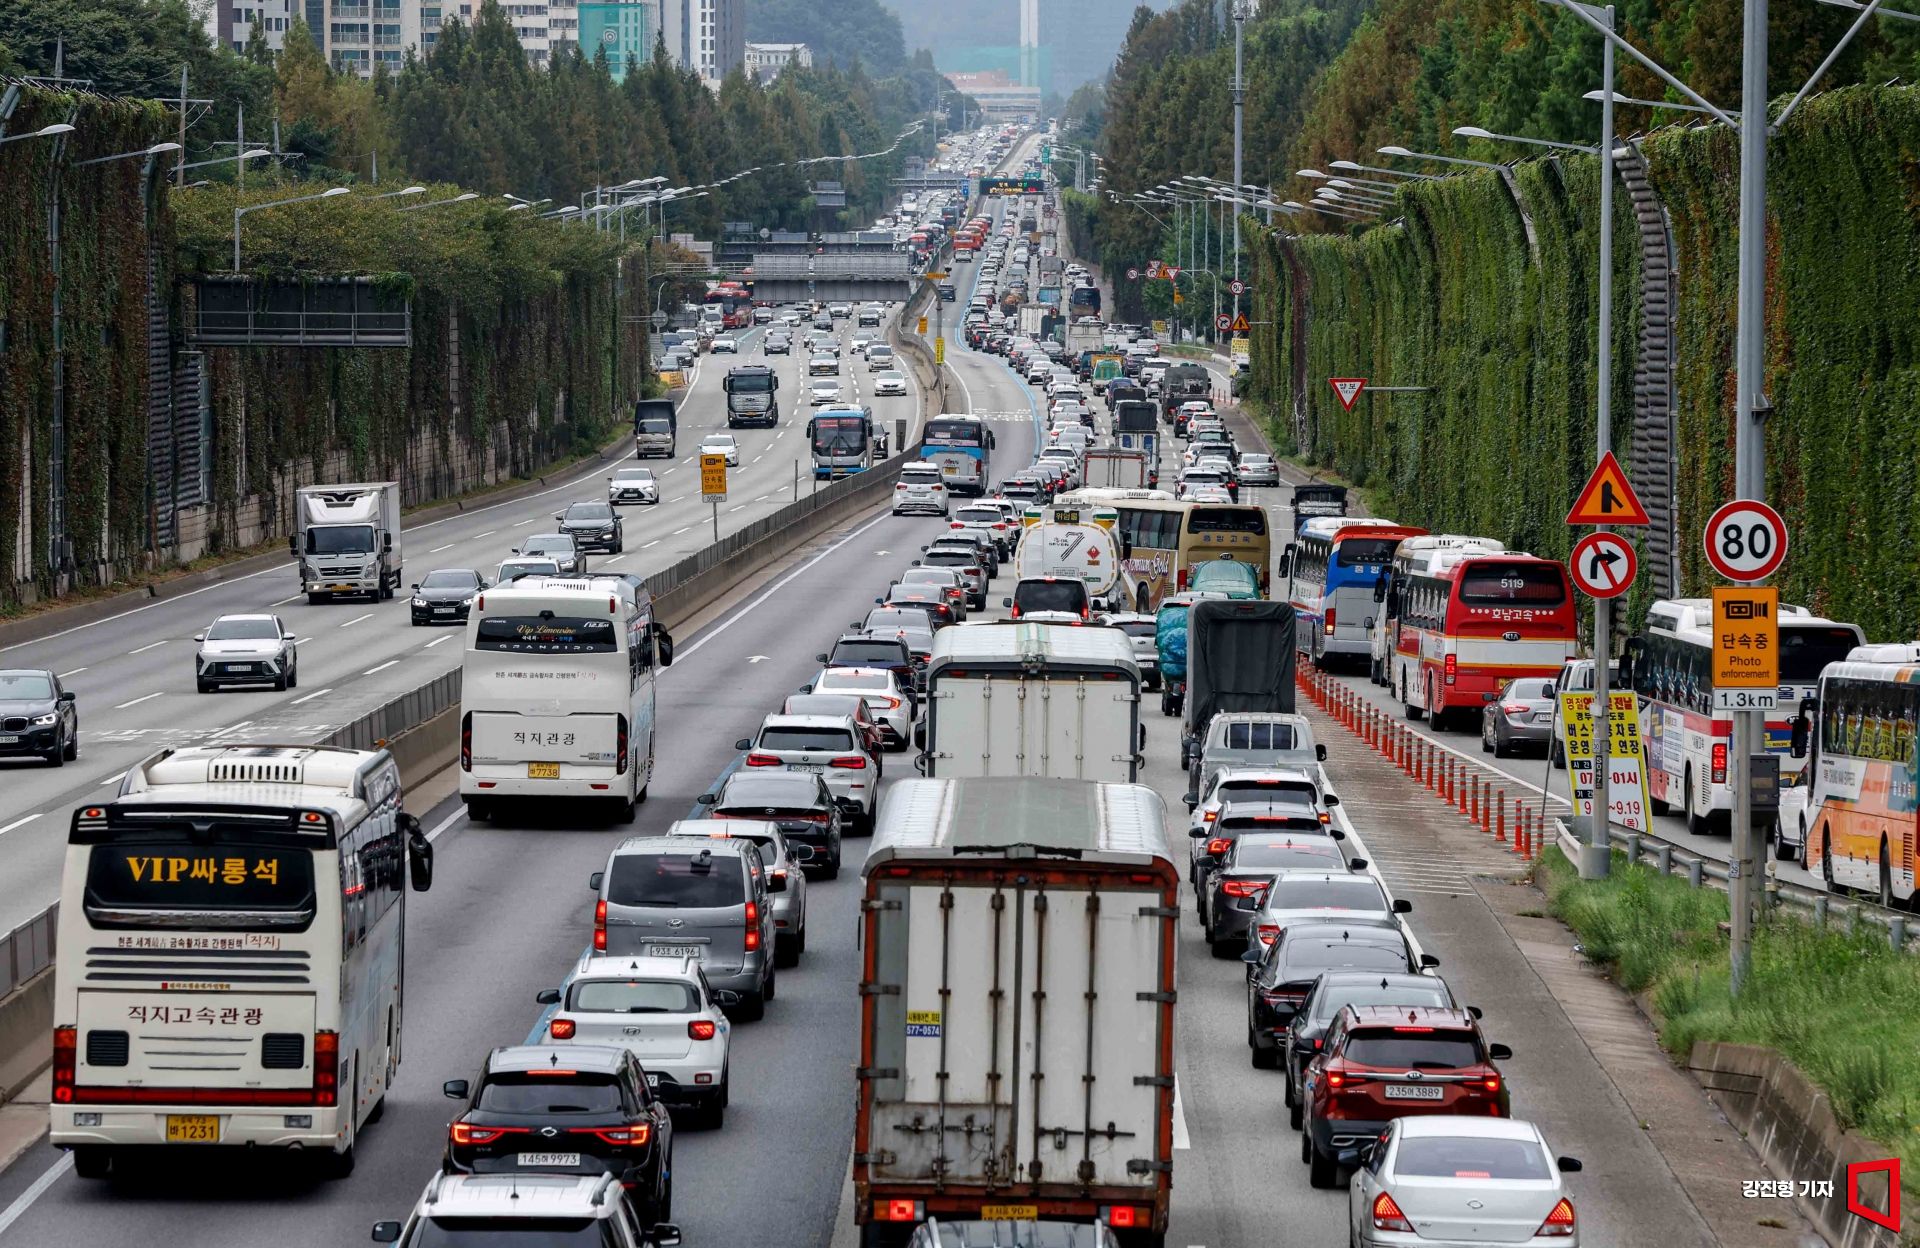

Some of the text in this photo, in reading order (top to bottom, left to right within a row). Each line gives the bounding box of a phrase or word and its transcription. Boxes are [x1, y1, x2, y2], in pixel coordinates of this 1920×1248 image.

[1722, 523, 1771, 560] 80
[1501, 578, 1524, 588] 5119
[1492, 607, 1533, 622] 호남고속
[516, 624, 577, 635] Vip Limousine
[1504, 632, 1519, 640] KIA
[1722, 633, 1768, 650] 단속중
[1729, 655, 1762, 666] Photo
[1721, 668, 1770, 679] enforcement
[1721, 692, 1773, 707] 1.3km
[513, 732, 576, 745] 직지관광
[1570, 740, 1590, 755] 운영
[1618, 740, 1639, 755] 연장
[1572, 760, 1591, 769] 시간
[127, 856, 278, 885] VIP싸롱석
[170, 937, 209, 949] 금속활자로
[128, 1005, 264, 1025] 직지고속관광
[170, 1125, 214, 1139] 바1231
